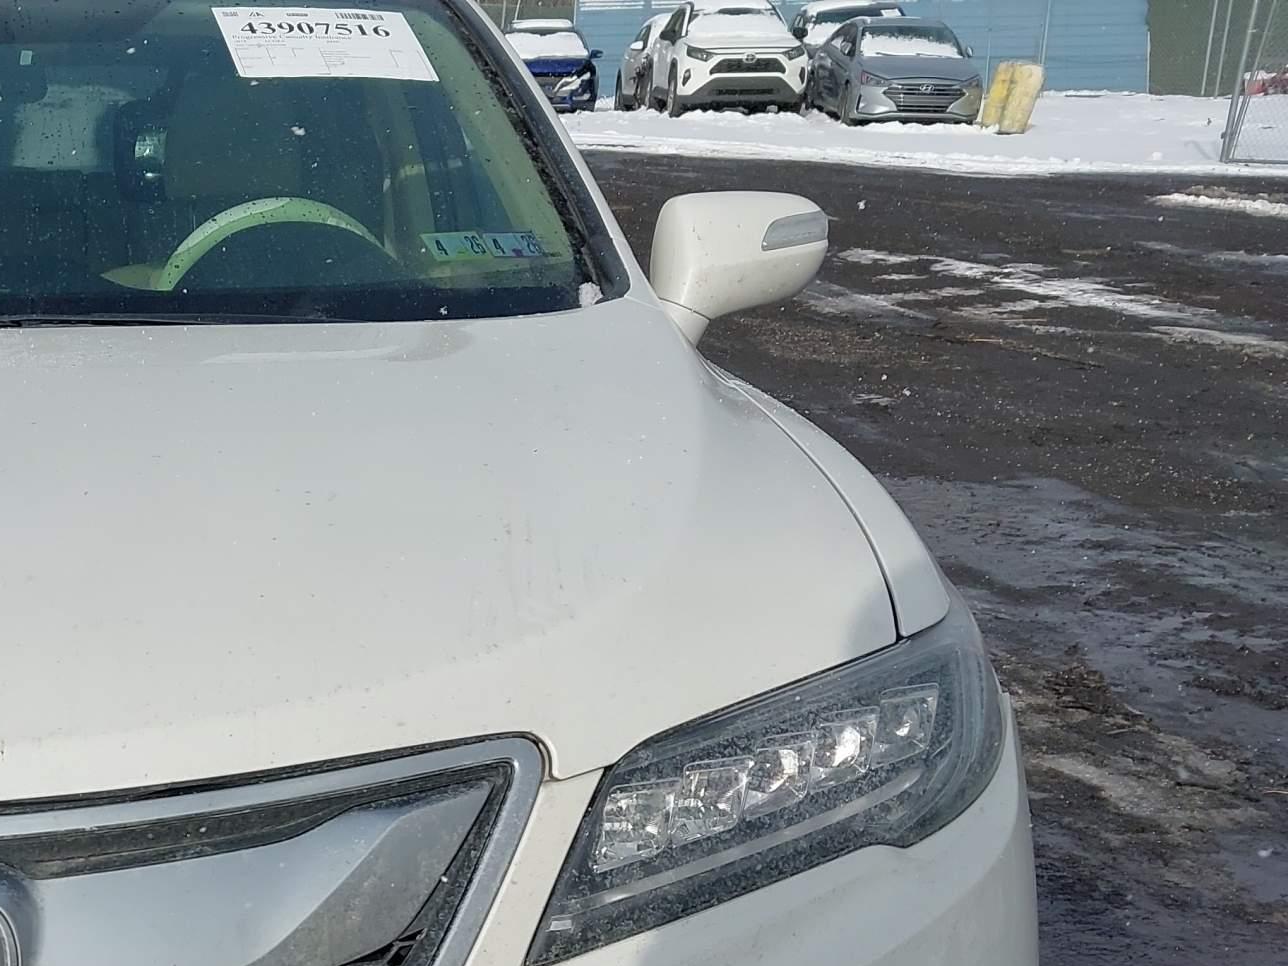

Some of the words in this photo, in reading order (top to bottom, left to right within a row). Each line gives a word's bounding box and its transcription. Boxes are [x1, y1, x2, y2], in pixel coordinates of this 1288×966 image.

[240, 21, 391, 38] 43907516
[435, 239, 449, 256] 4
[464, 235, 487, 255] 26
[492, 238, 507, 255] 4
